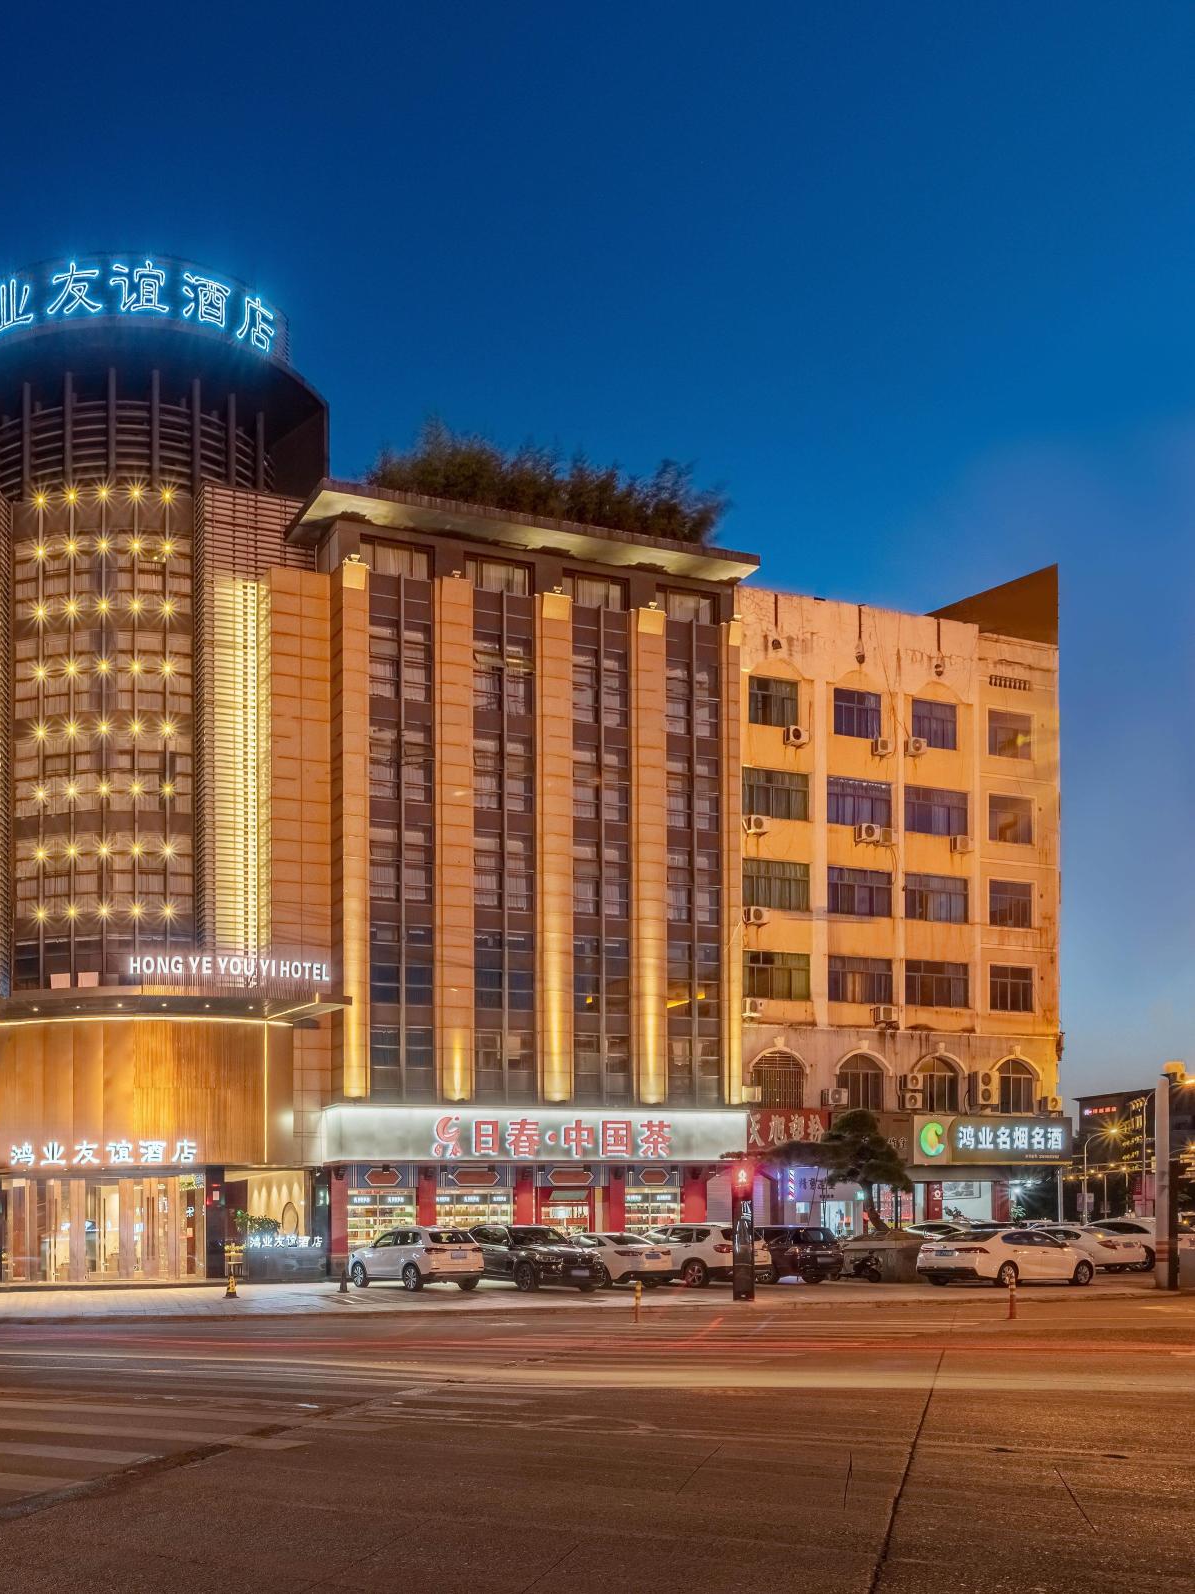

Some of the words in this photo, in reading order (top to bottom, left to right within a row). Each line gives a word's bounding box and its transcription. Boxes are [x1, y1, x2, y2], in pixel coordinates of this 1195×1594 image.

[129, 955, 185, 975] HONG
[189, 956, 212, 975] YE
[217, 957, 256, 976] YOU
[260, 959, 276, 977] YI
[280, 960, 331, 982] HOTEL
[958, 1125, 1063, 1150] 鸿业名烟名酒
[10, 1140, 198, 1166] 鸿业友谊酒店
[248, 1234, 323, 1249] 鸿业友谊酒店
